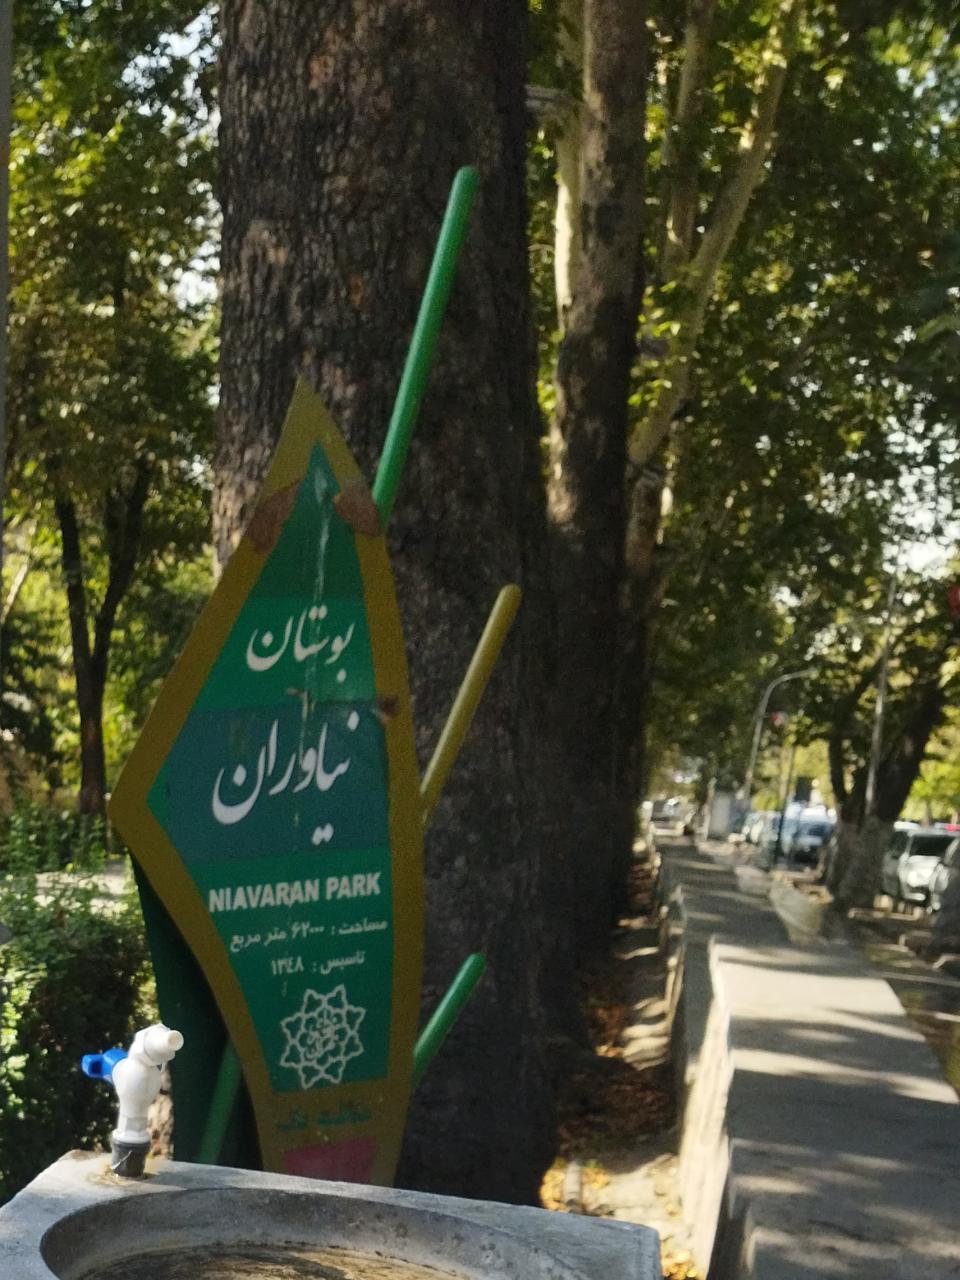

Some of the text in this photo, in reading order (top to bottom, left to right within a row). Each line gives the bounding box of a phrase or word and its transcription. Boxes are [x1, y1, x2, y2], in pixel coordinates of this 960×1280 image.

[246, 605, 355, 683] بوستان
[212, 711, 359, 845] نیاوران
[208, 871, 381, 912] NIAVARAN PARK
[230, 932, 261, 952] مربع
[263, 926, 287, 946] متر
